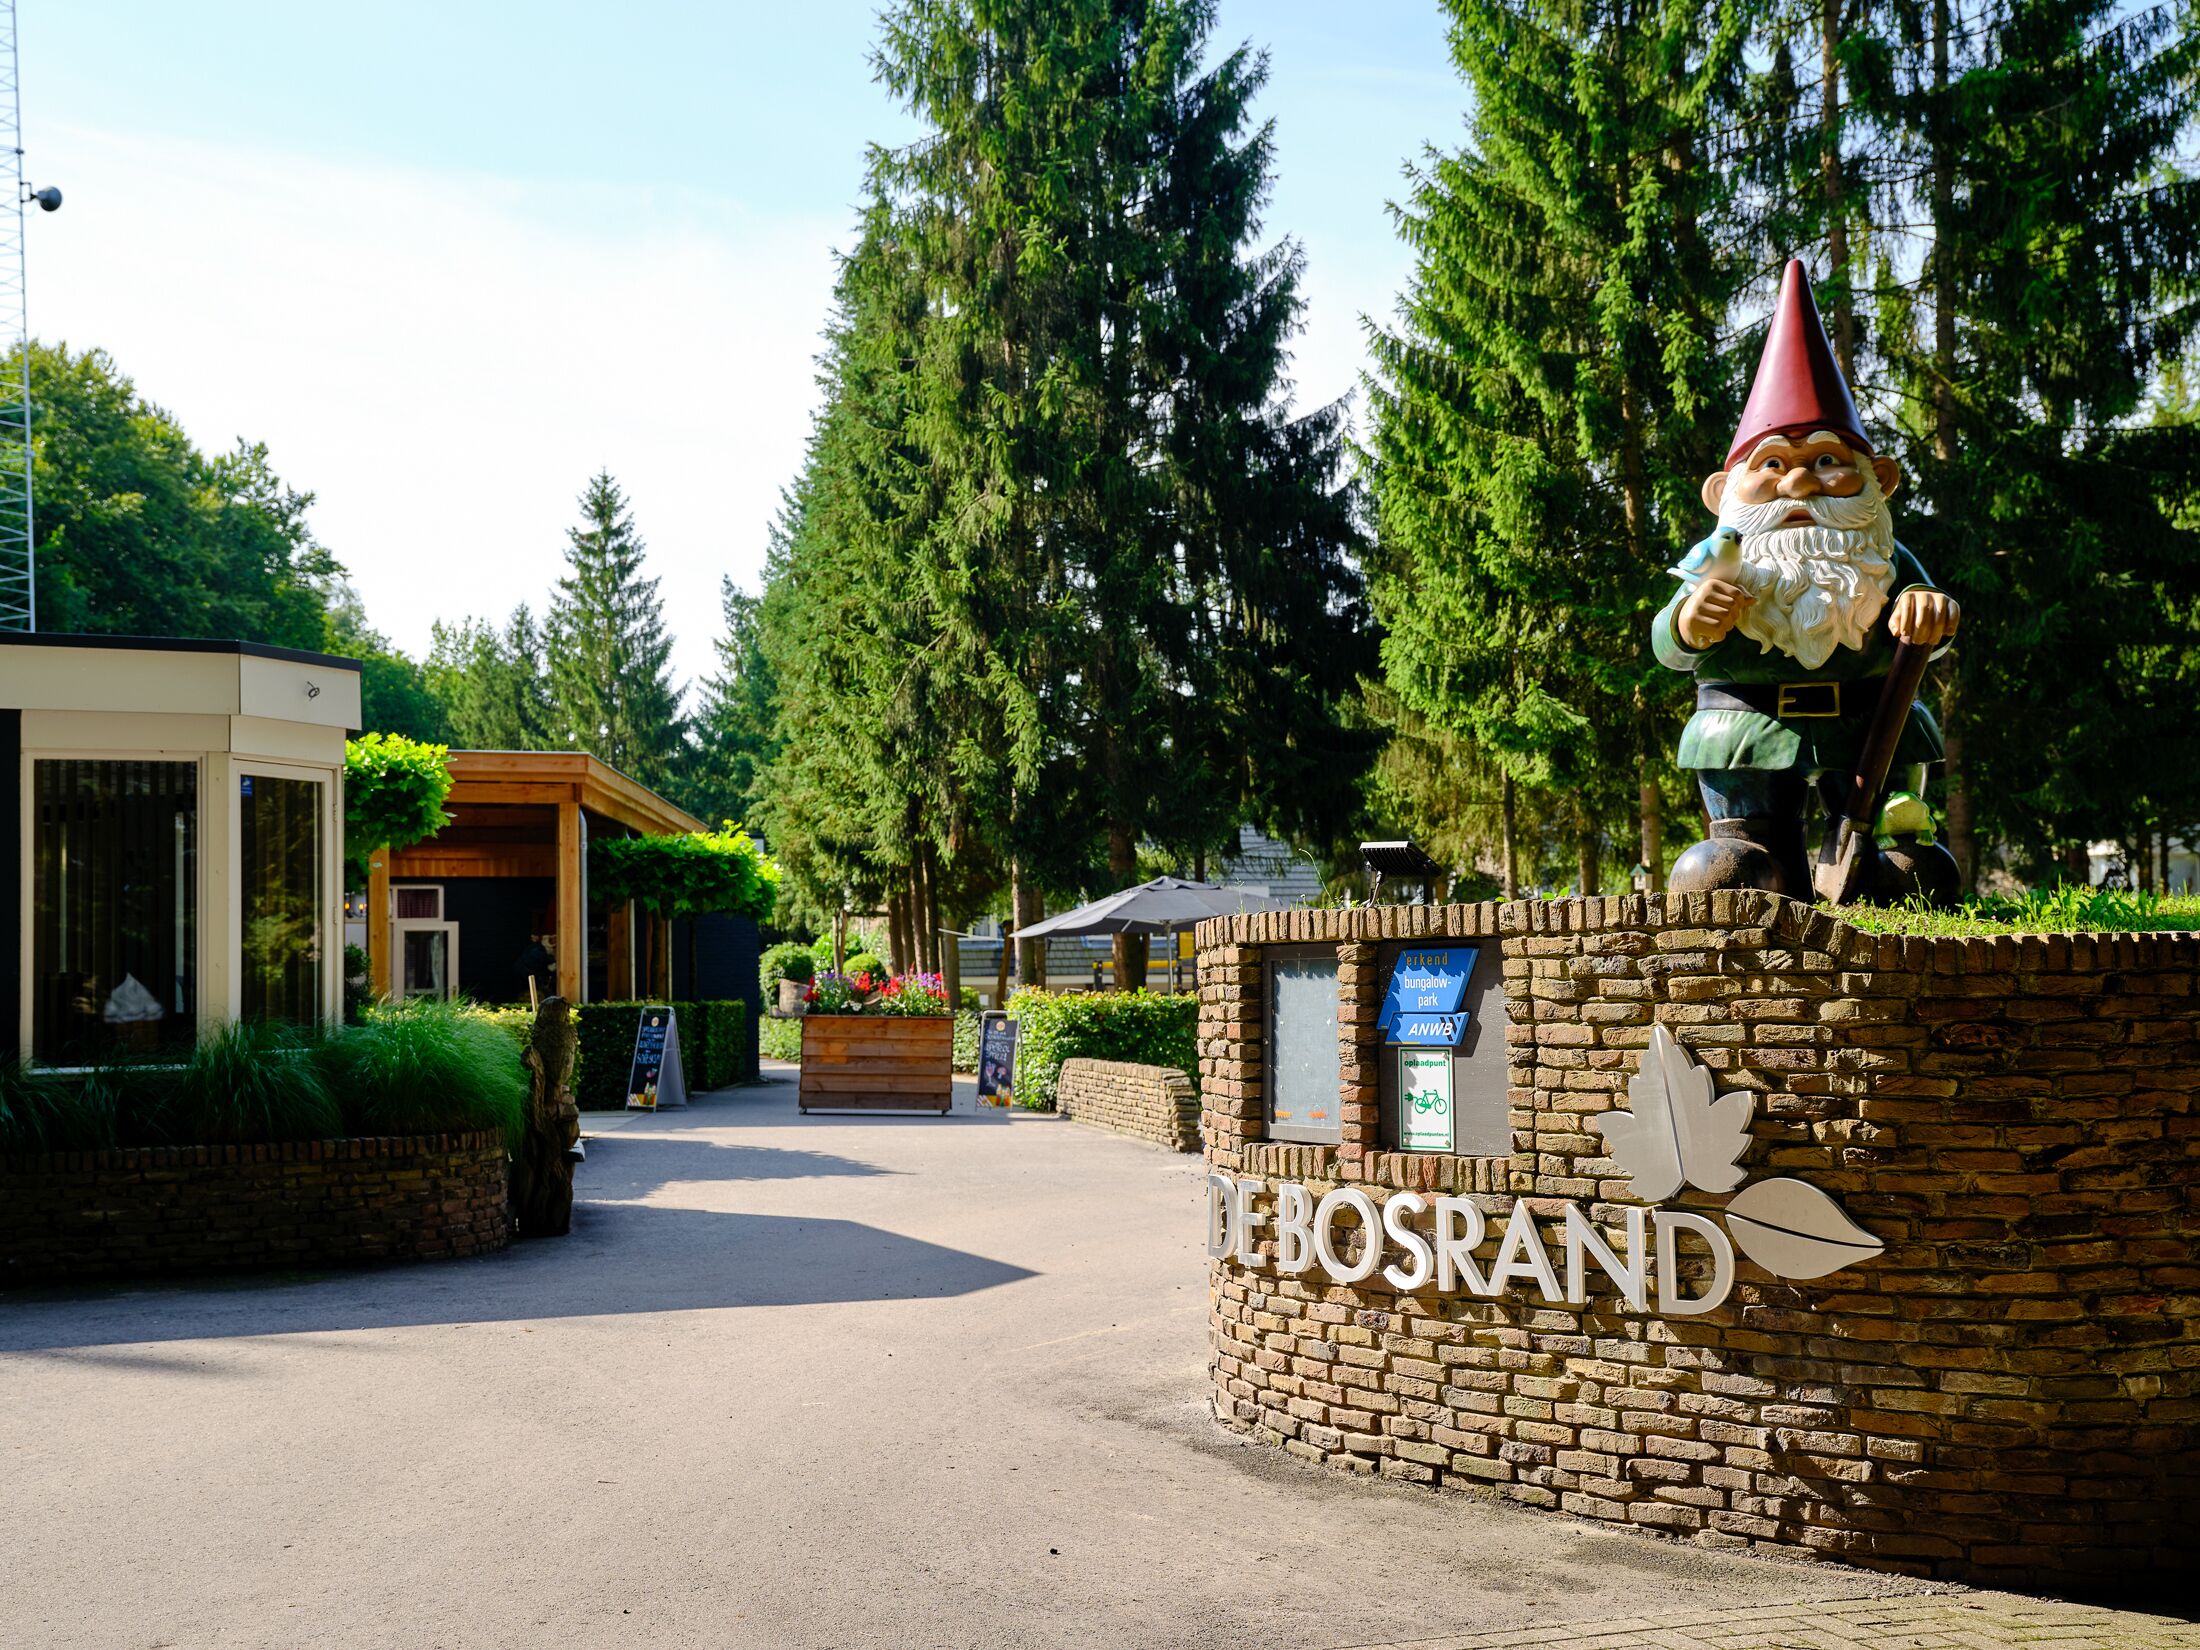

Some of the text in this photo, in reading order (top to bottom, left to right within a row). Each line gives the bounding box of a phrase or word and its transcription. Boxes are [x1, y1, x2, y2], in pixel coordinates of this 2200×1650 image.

[1406, 951, 1448, 967] erkend
[1404, 975, 1452, 992] bungalow-
[1418, 992, 1439, 1010] park
[1407, 1022, 1454, 1036] ANWB
[1404, 1059, 1446, 1068] oplaadpunt
[1208, 1173, 1734, 1315] DE BOSRAND
